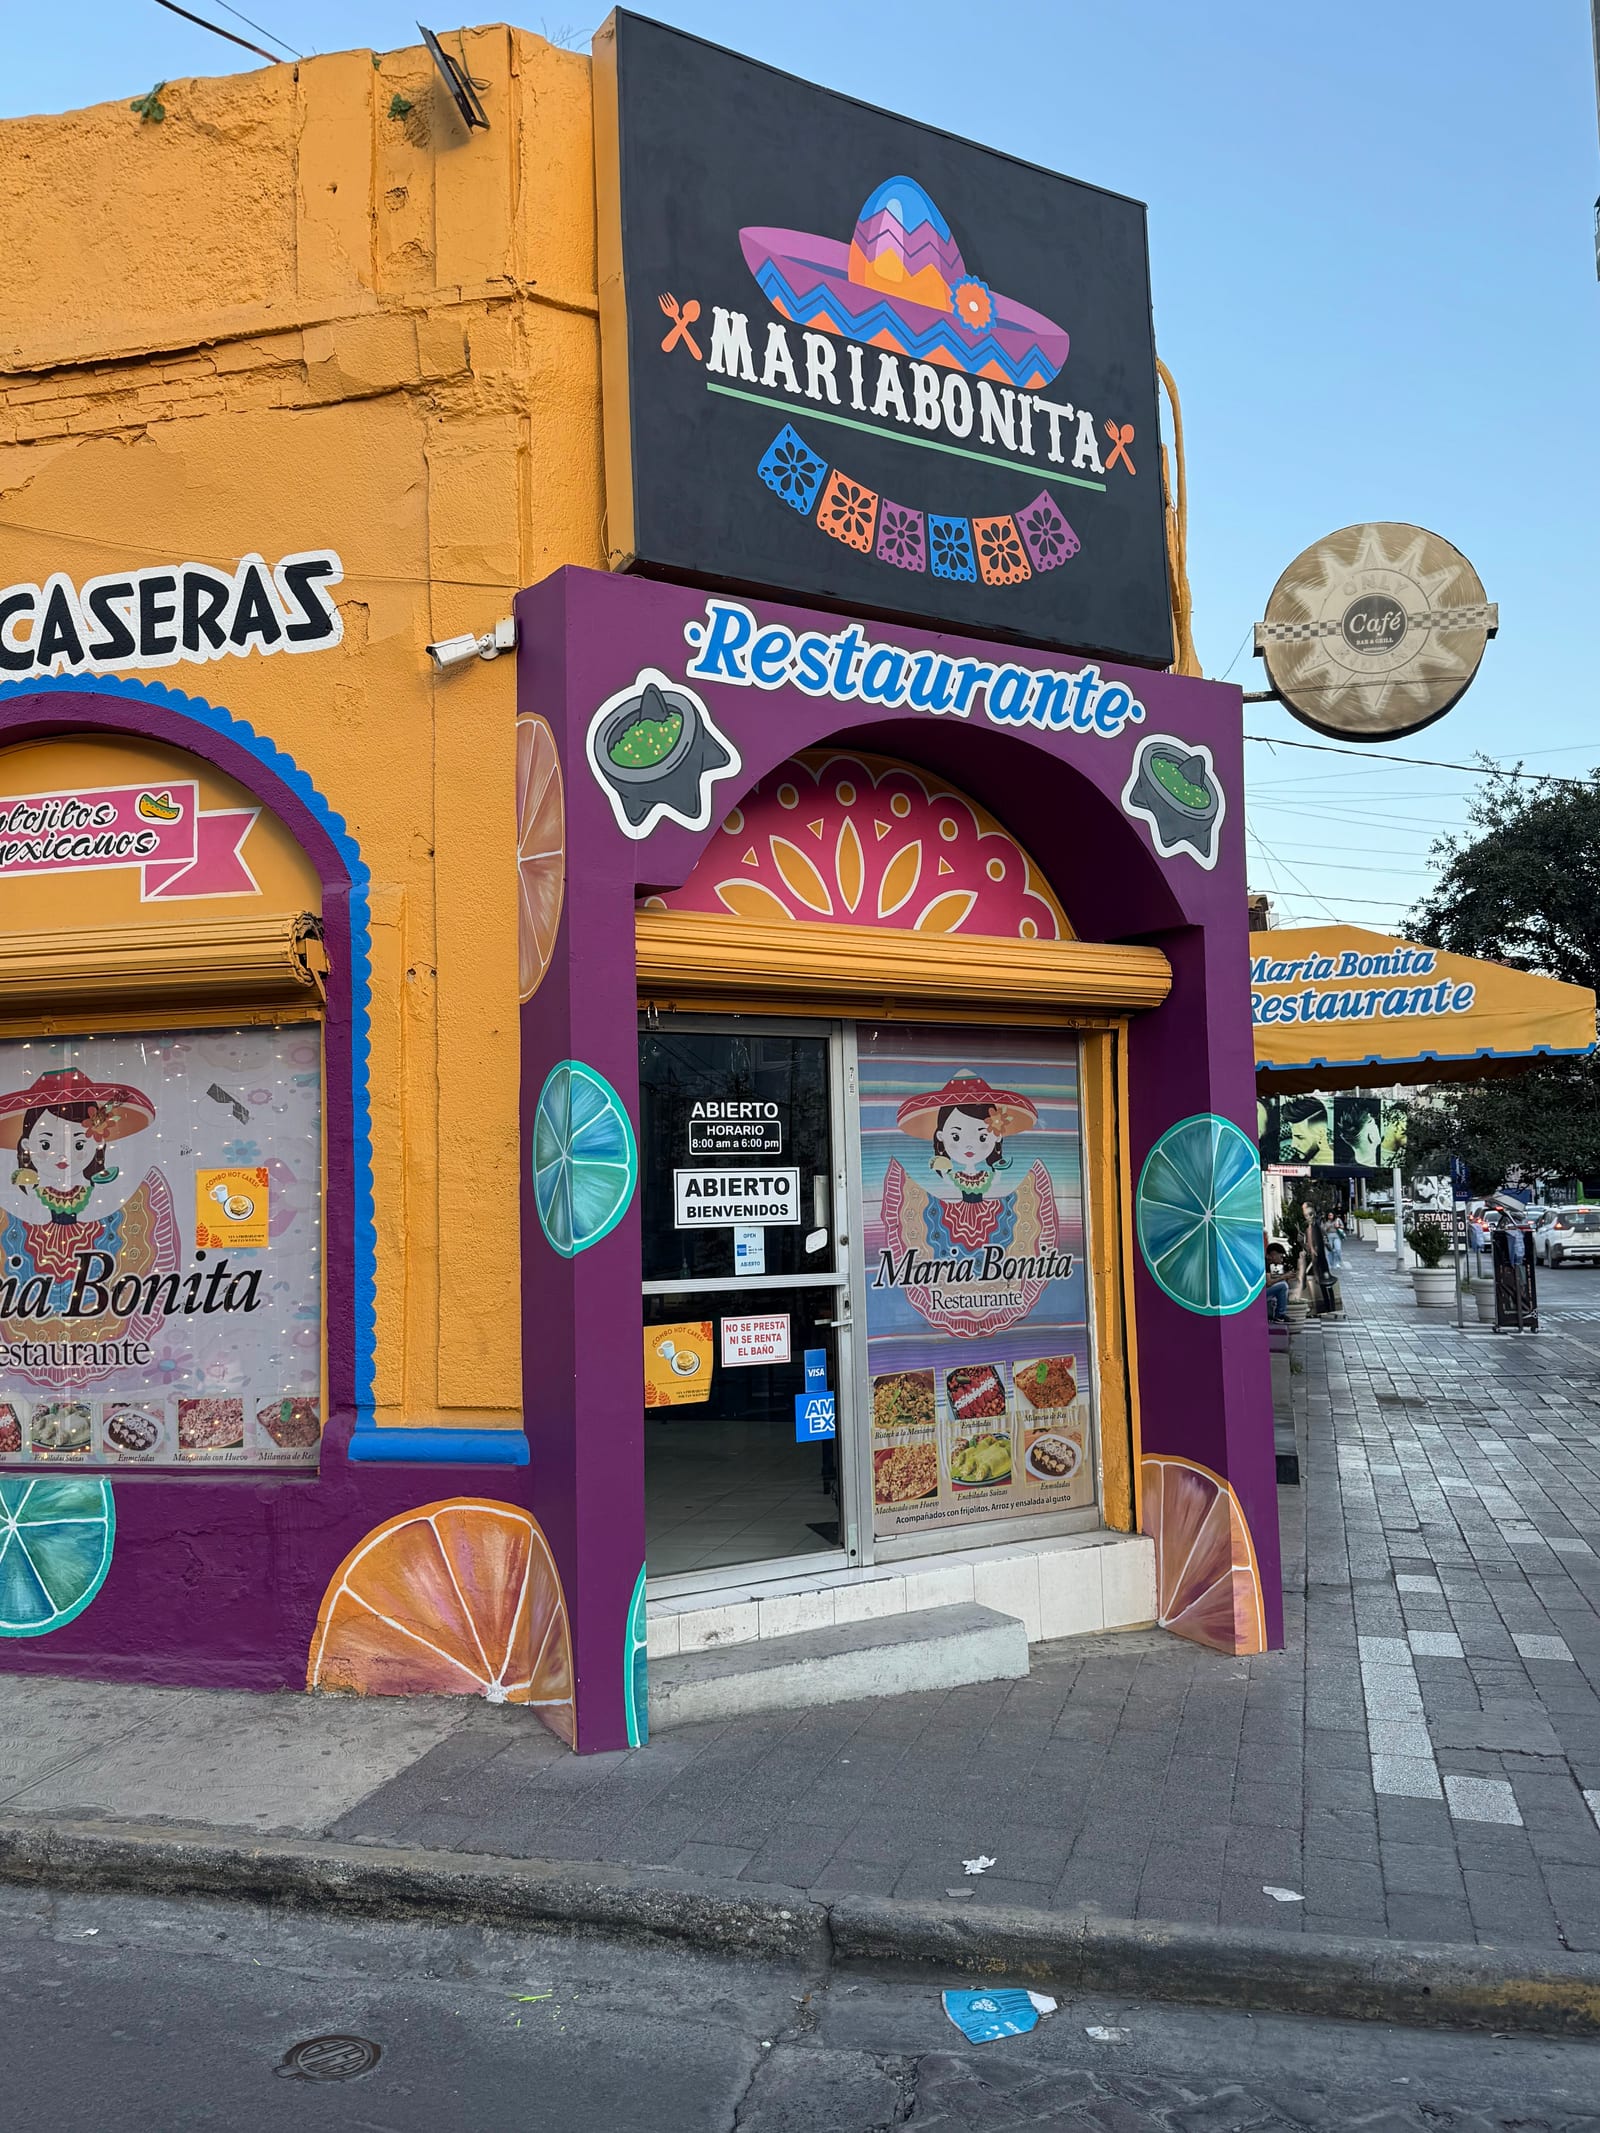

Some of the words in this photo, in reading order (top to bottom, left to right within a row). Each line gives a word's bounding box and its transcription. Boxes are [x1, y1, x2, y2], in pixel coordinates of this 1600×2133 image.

[705, 306, 1105, 474] MARIABONITA
[0, 557, 334, 671] CASERAS
[1349, 611, 1402, 637] Café
[694, 604, 1130, 733] Restaurante
[0, 831, 158, 867] exicanos
[1250, 953, 1334, 983] Maria
[1335, 948, 1435, 978] Bonita
[691, 1101, 779, 1119] ABIERTO
[706, 1125, 765, 1136] HORARIO
[692, 1138, 714, 1149] 8:00
[715, 1140, 731, 1148] am
[733, 1140, 740, 1148] a
[741, 1138, 762, 1148] 6:00
[764, 1140, 779, 1150] pm
[685, 1176, 790, 1198] ABIERTO
[686, 1203, 789, 1218] BIENVENIDOS
[872, 1249, 973, 1288] Maria
[978, 1245, 1073, 1282] Bonita
[62, 1250, 263, 1318] Bonita
[931, 1289, 1023, 1311] Restaurante
[725, 1324, 738, 1333] NO
[740, 1323, 751, 1332] SE
[753, 1321, 785, 1331] PRESTA
[729, 1336, 739, 1345] NI
[741, 1335, 752, 1344] SE
[754, 1333, 782, 1343] RENTA
[0, 1339, 151, 1367] estaurante
[738, 1347, 748, 1357] EL
[750, 1344, 774, 1356] BAÑO
[807, 1368, 825, 1377] VISA
[805, 1399, 834, 1419] AM
[258, 1452, 290, 1461] Milanesa
[291, 1452, 301, 1460] de
[896, 1510, 946, 1524] Acompañados
[946, 1508, 959, 1517] con
[991, 1503, 1009, 1512] Arroz
[1010, 1502, 1016, 1510] y
[1015, 1498, 1046, 1508] ensalada
[1045, 1496, 1052, 1504] al
[1052, 1494, 1072, 1505] gusto
